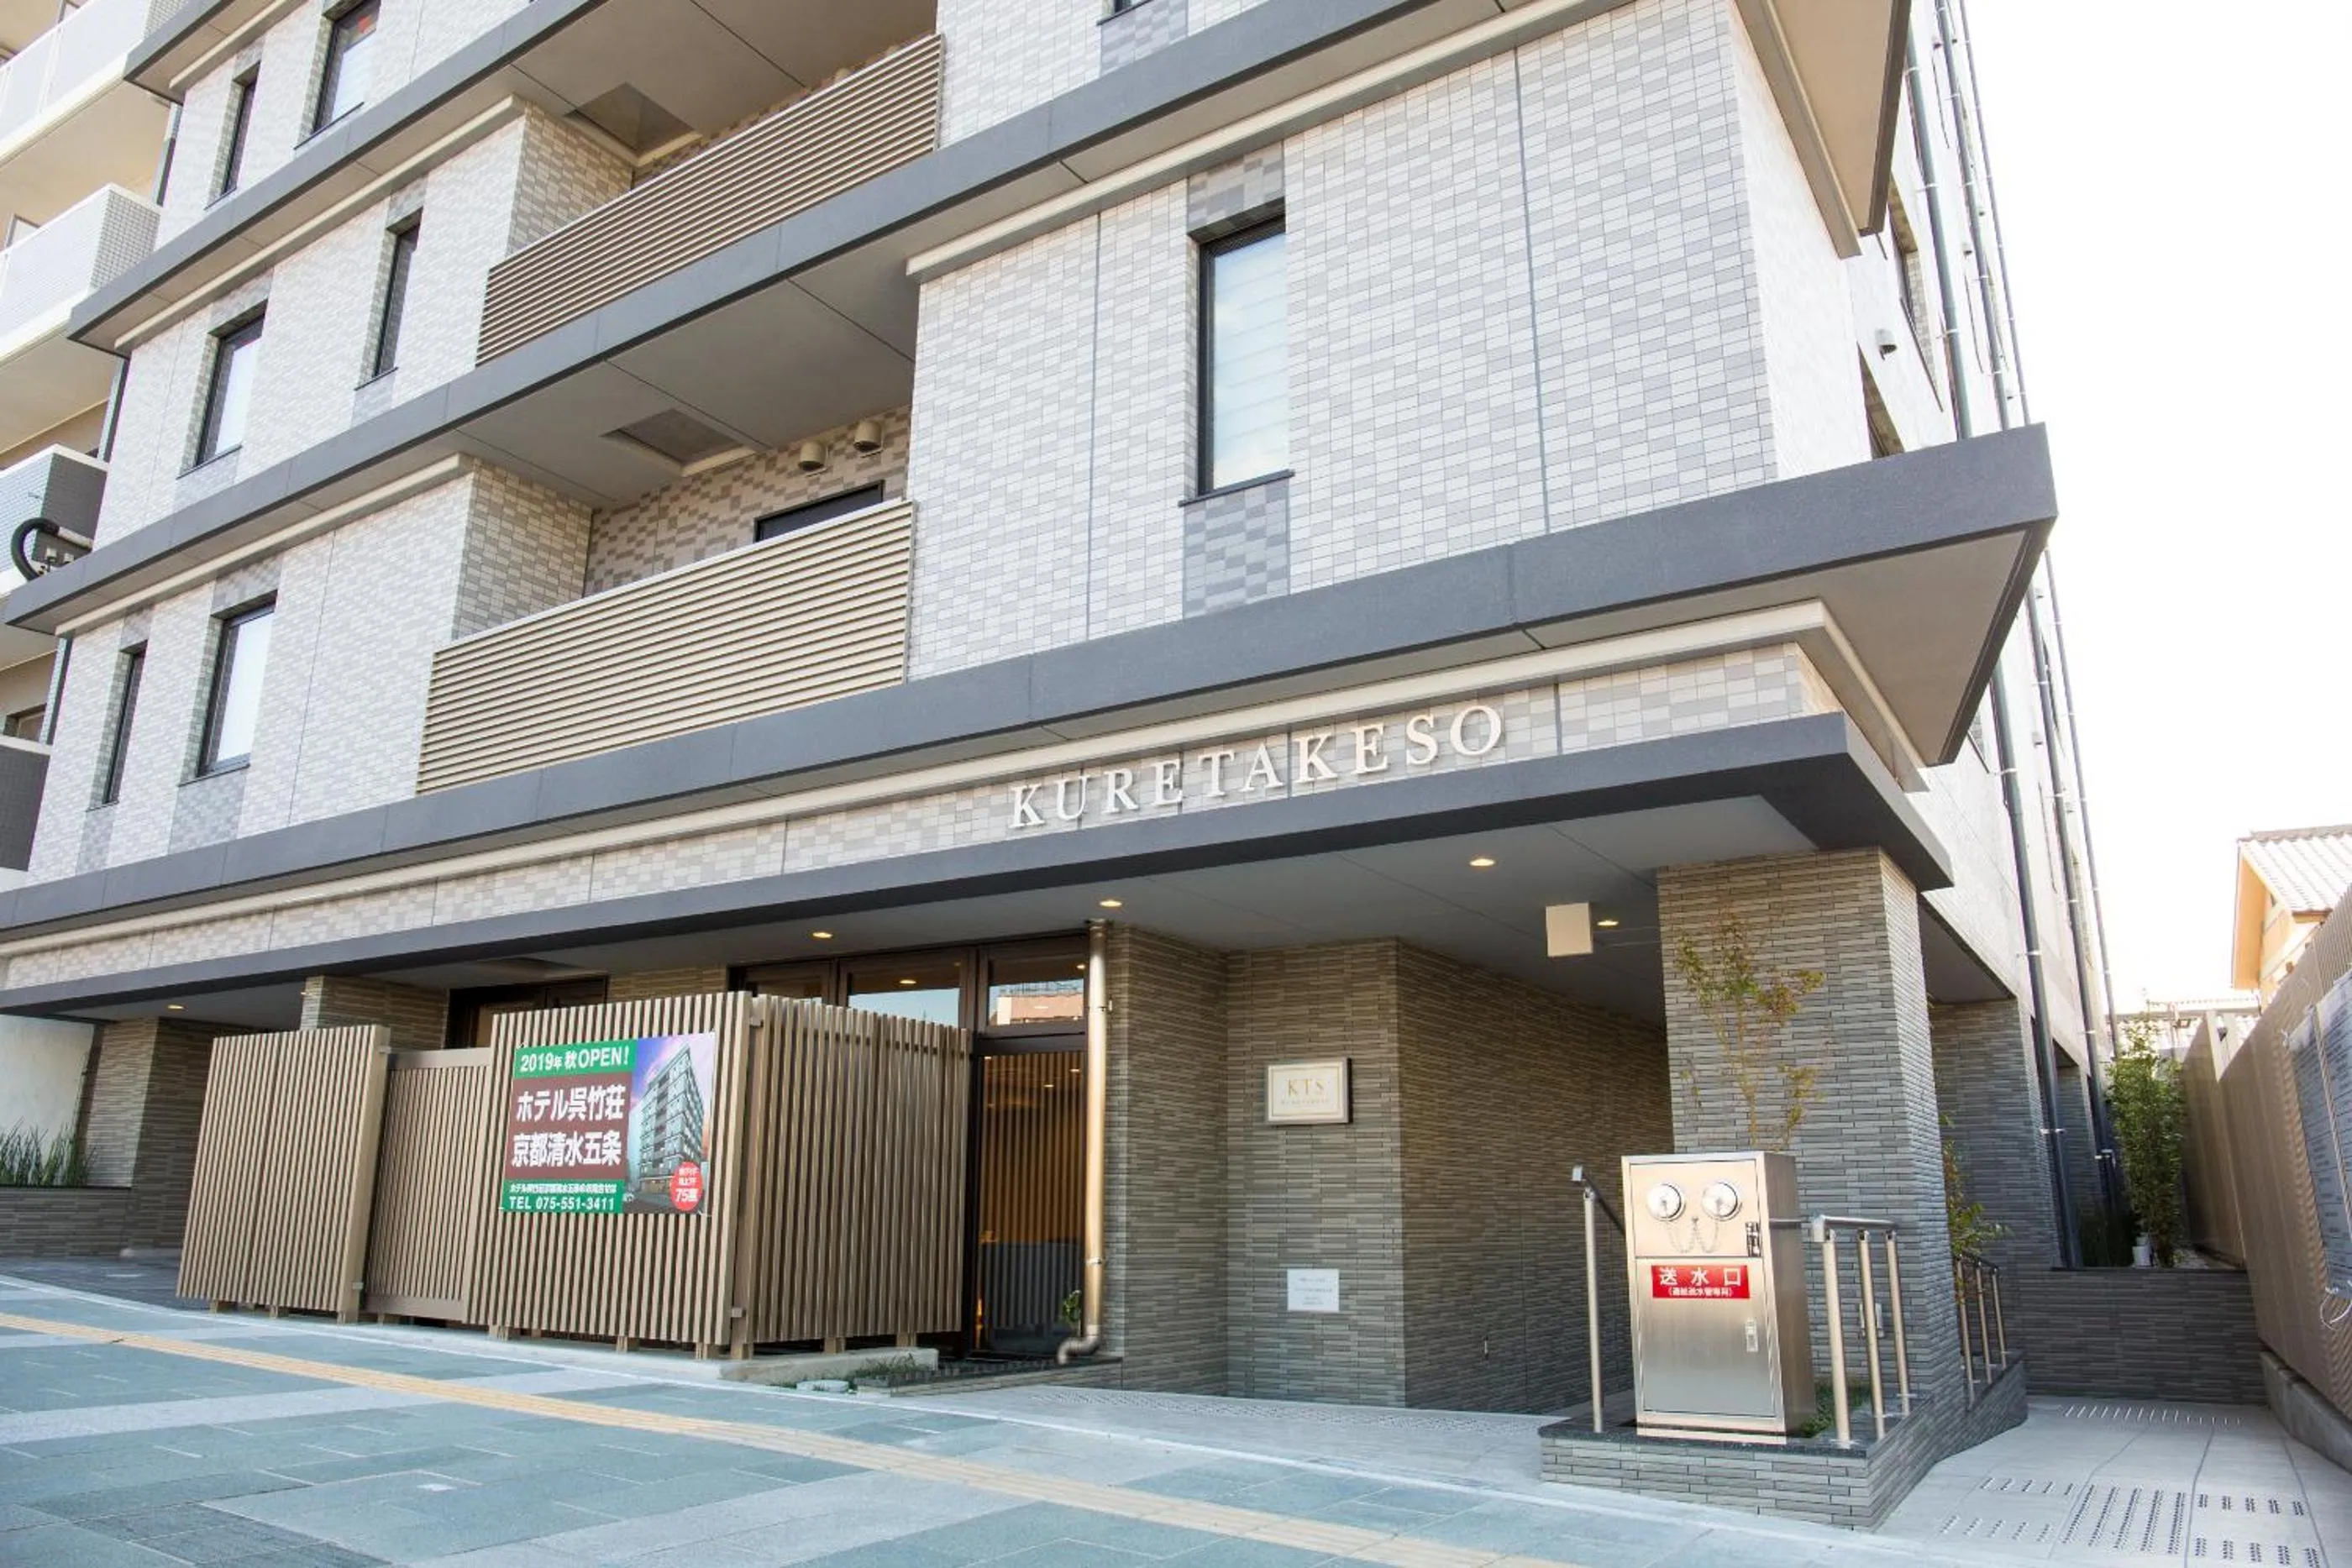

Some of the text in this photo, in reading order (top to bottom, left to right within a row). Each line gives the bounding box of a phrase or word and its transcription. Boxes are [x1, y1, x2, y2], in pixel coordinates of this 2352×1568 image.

[1011, 705, 1503, 830] KURETAKESO
[517, 1084, 626, 1122] ホテル呉竹荘
[512, 1130, 622, 1167] 京都清水五条
[509, 1196, 615, 1210] TEL 075-551-3411
[1660, 1266, 1741, 1287] 送水口
